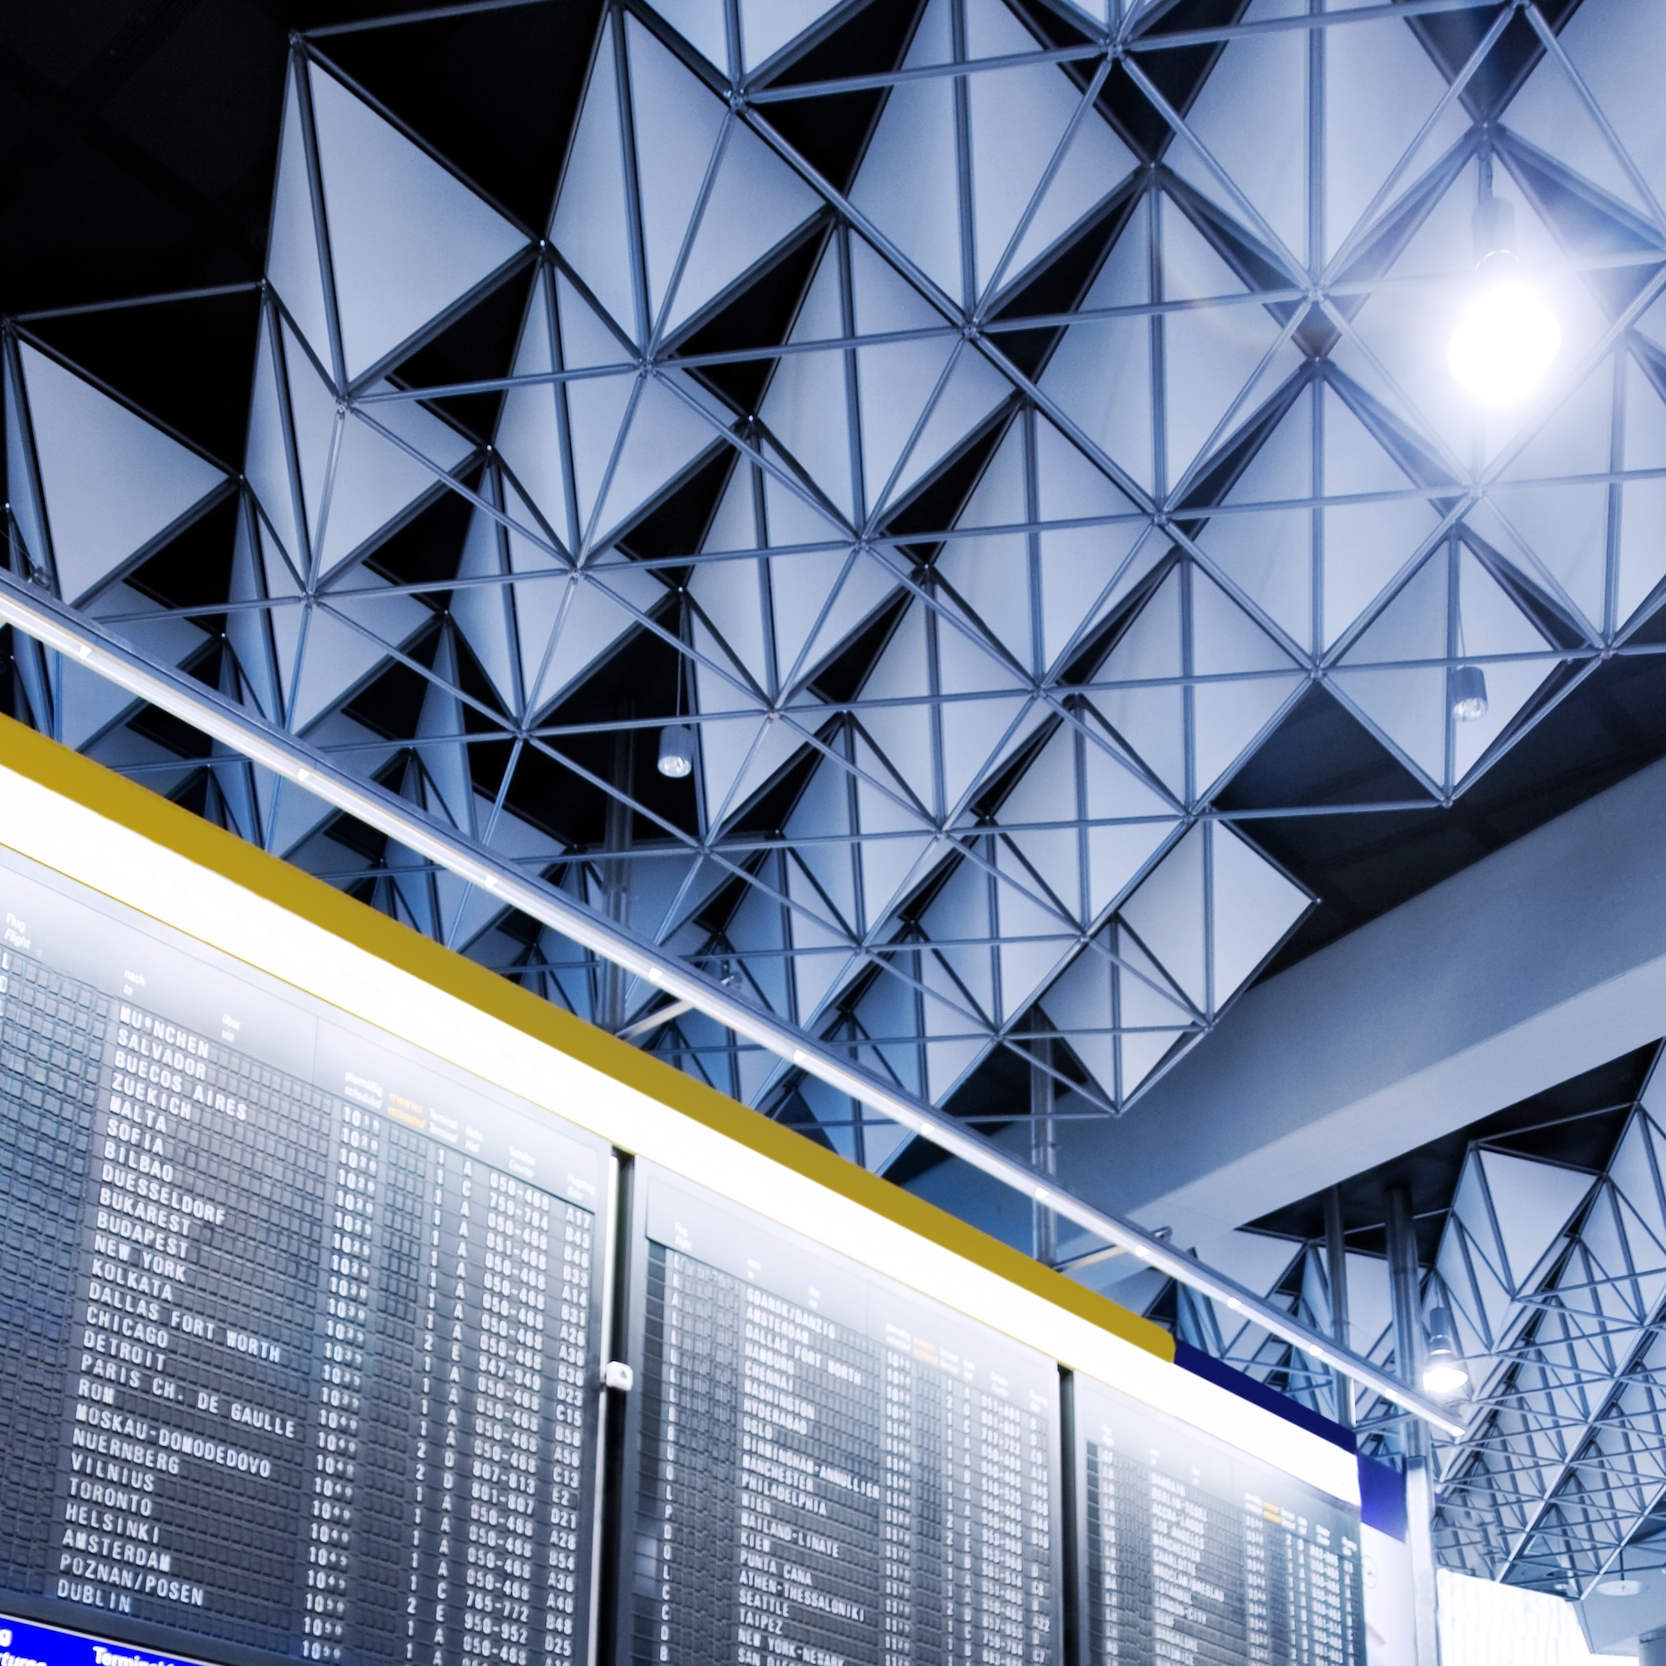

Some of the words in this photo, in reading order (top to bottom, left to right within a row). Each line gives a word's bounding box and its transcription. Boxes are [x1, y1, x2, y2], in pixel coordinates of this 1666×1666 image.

[117, 1030, 206, 1080] SALVADOR
[105, 1138, 173, 1182] BILBAO
[100, 1188, 191, 1235] BUKAREST
[102, 1161, 225, 1224] DUESSELDORF
[97, 1208, 188, 1258] BUDAPEST
[95, 1231, 131, 1260] NEW
[143, 1251, 185, 1281] YORK
[92, 1258, 173, 1301] KOLKATA
[87, 1303, 169, 1348] CHICAGO
[83, 1330, 165, 1370] DETROIT
[79, 1378, 115, 1404] ROM
[73, 1428, 179, 1474] NUERNBERG
[76, 1404, 271, 1477] MOSKAU-DOMODEDOVO
[72, 1452, 154, 1491] VILNIUS
[70, 1477, 152, 1516] TORONTO
[66, 1502, 159, 1543] HELSINKI
[63, 1528, 171, 1572] AMSTERDAM
[57, 1579, 131, 1612] DUBLIN
[60, 1554, 203, 1605] POZNAN/POSEN
[739, 1587, 789, 1616] SEATTLE
[739, 1608, 783, 1634] TAIPEZ
